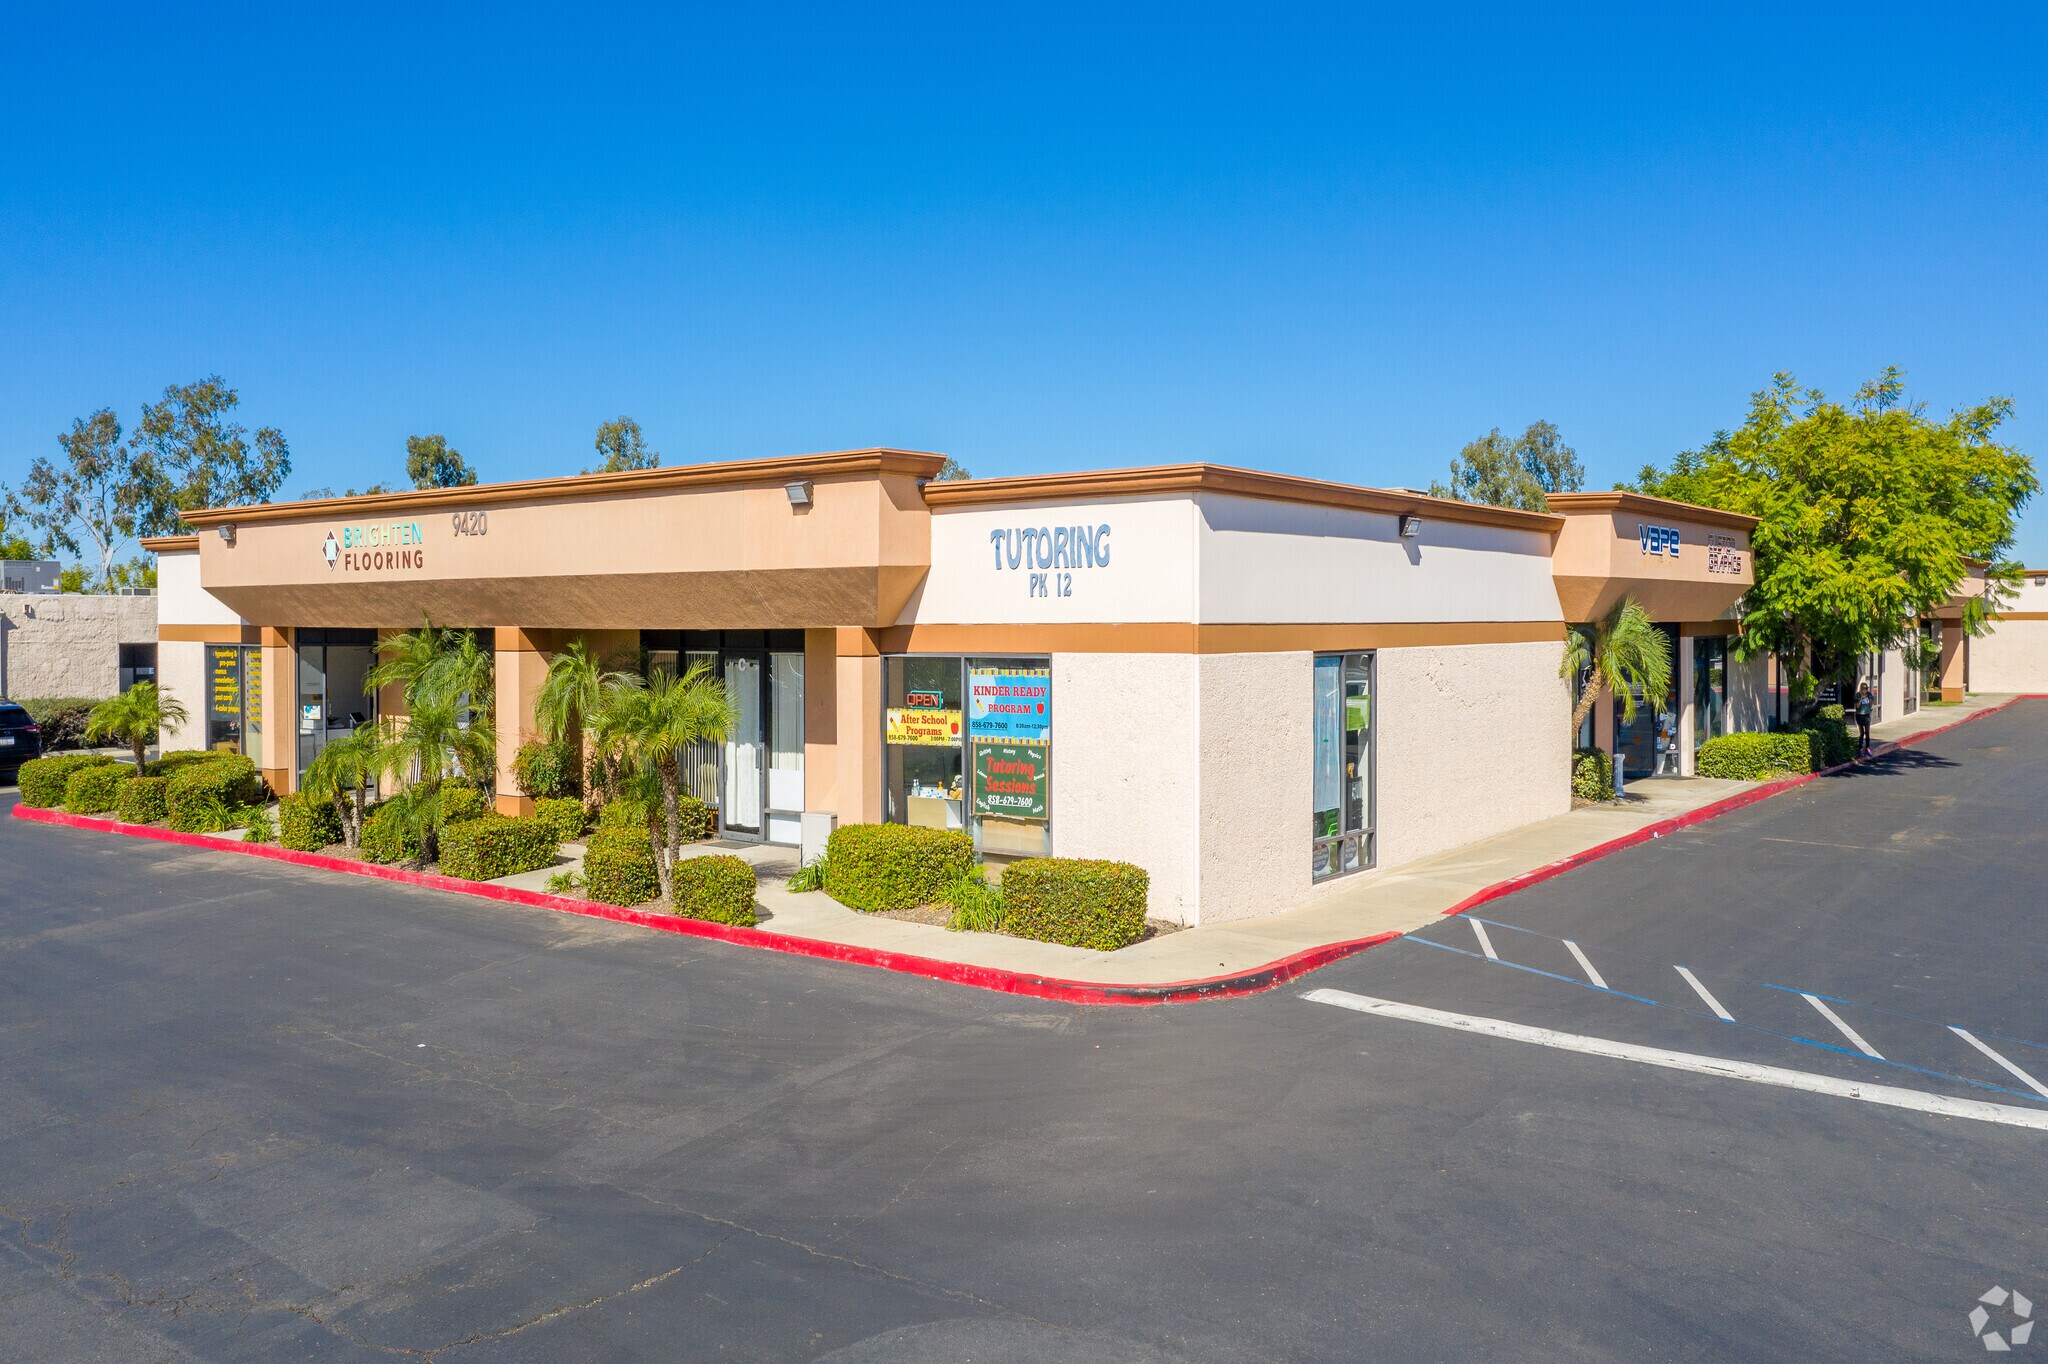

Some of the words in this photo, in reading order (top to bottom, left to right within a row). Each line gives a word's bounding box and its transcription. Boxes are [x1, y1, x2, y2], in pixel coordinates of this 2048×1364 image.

[452, 510, 488, 537] 9420
[343, 521, 423, 549] BRIGHTEN
[990, 523, 1111, 570] TUTORING
[344, 549, 424, 571] FLOORING
[1708, 554, 1742, 574] GRAPHICS
[1029, 572, 1048, 598] PK
[1056, 572, 1072, 598] 12
[738, 657, 746, 671] C
[973, 685, 1011, 696] KINDER
[1013, 686, 1047, 698] READY
[906, 693, 939, 707] OPEN
[987, 703, 1032, 714] PROGRAM
[900, 714, 920, 724] After
[921, 714, 948, 725] School
[971, 721, 1008, 729] 858-679-7600
[906, 726, 942, 737] Programs
[1028, 749, 1042, 759] Physics
[986, 756, 1036, 781] Tutoring
[984, 775, 1037, 795] Sessions
[975, 797, 991, 811] English
[987, 794, 1034, 807] 858-679-7600
